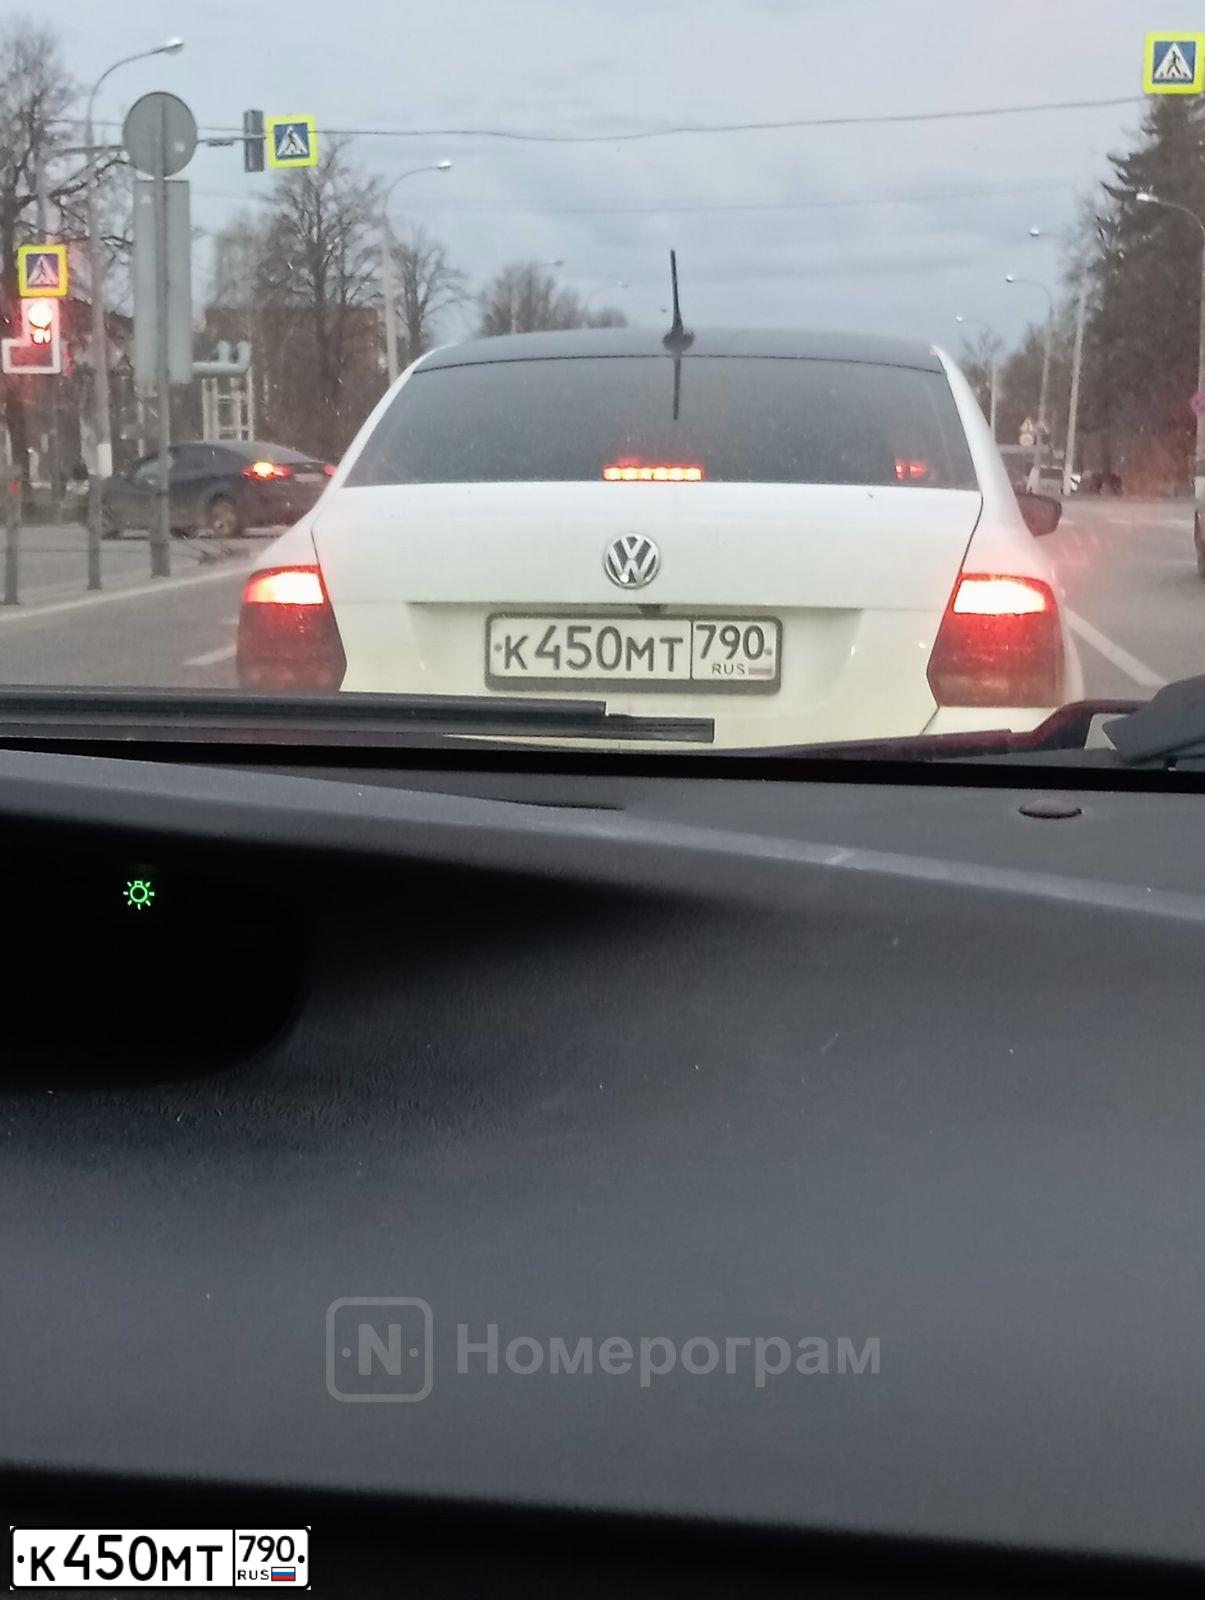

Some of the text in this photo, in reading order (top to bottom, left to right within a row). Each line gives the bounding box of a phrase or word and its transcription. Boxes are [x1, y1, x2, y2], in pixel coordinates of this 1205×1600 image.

[504, 624, 765, 672] К450МТ 790
[711, 663, 745, 675] RUS
